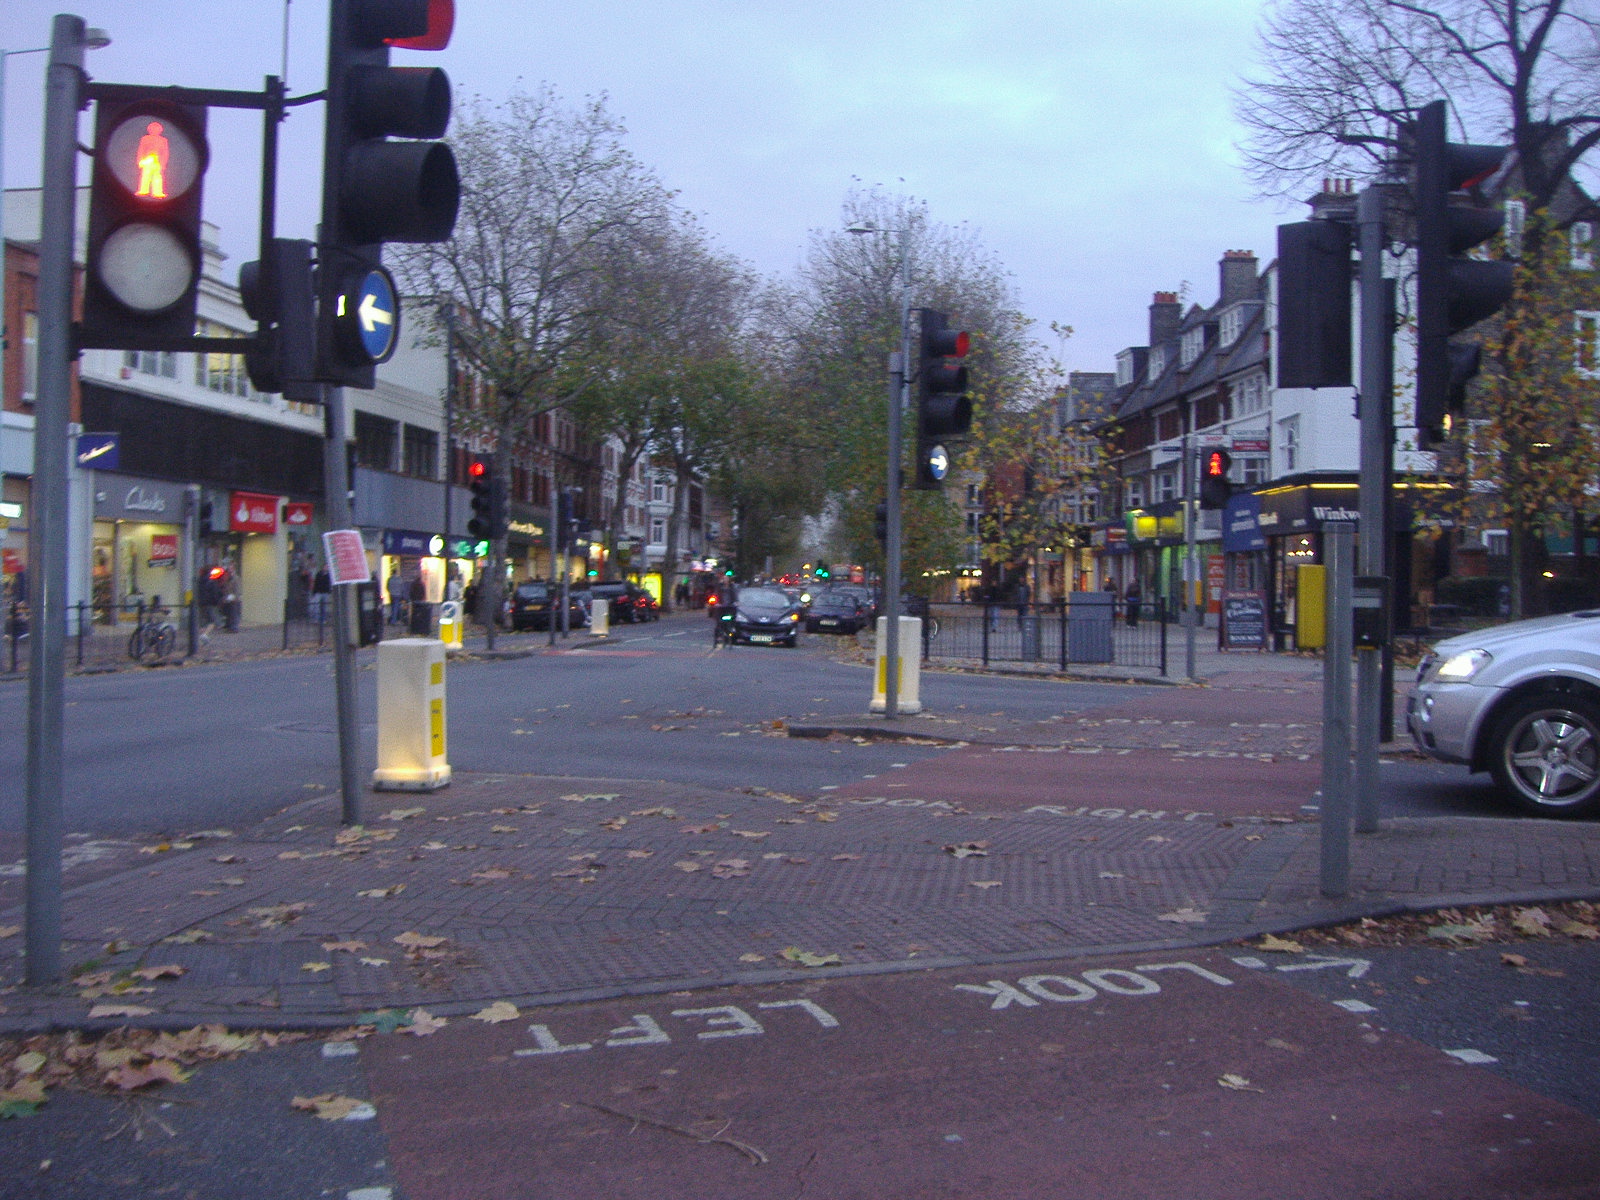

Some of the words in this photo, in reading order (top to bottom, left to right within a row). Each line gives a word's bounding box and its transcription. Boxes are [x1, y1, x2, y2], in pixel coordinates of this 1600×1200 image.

[124, 486, 166, 512] Clarks
[954, 961, 1235, 1010] LOOK
[513, 999, 839, 1056] LEFT
